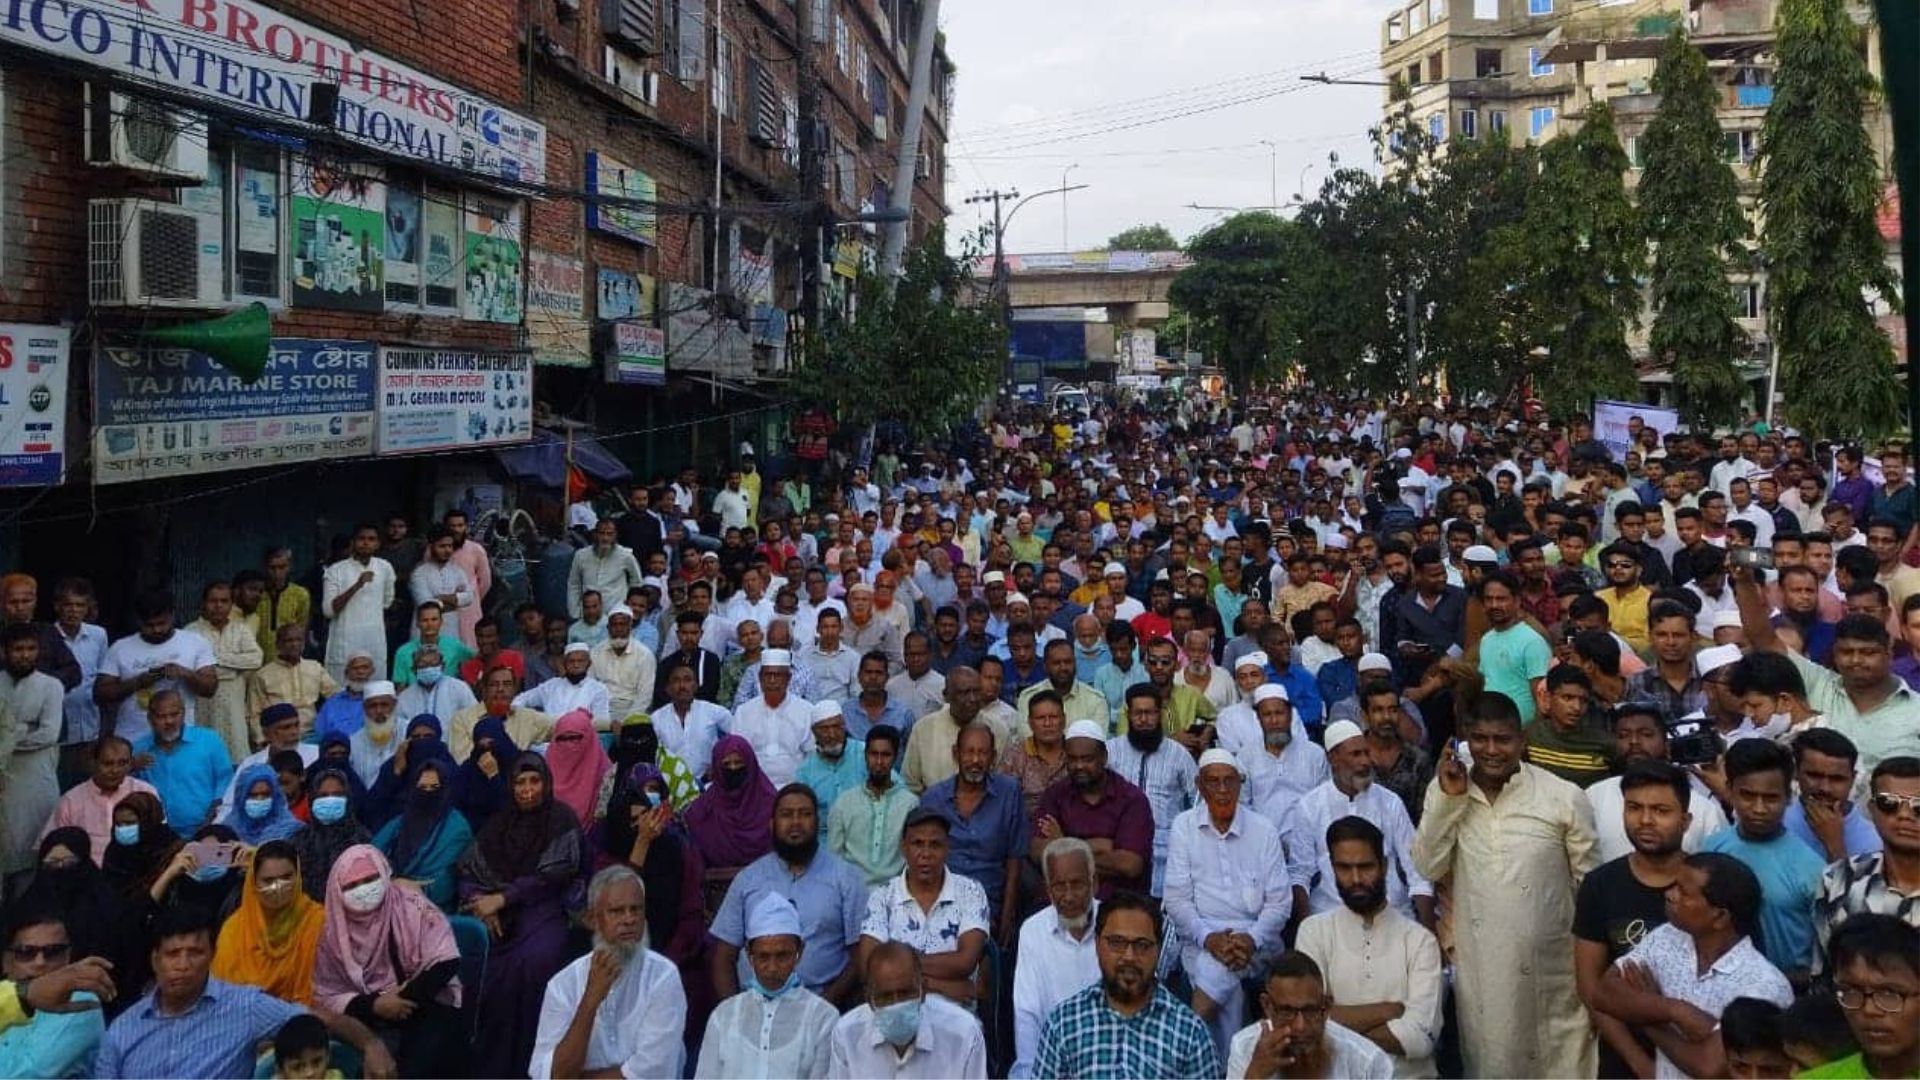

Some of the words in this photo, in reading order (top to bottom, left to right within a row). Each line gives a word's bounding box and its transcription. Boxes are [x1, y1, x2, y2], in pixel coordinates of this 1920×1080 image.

[181, 0, 456, 123] BROTHERS
[125, 24, 456, 166] INTERNTIONAL
[459, 101, 478, 131] CAT
[386, 351, 436, 370] CUMMINS
[438, 352, 476, 371] PERKINS
[477, 353, 527, 372] CATERPILLAR
[122, 376, 173, 394] TAJ
[289, 374, 358, 390] STORE
[450, 390, 486, 404] MOTORS
